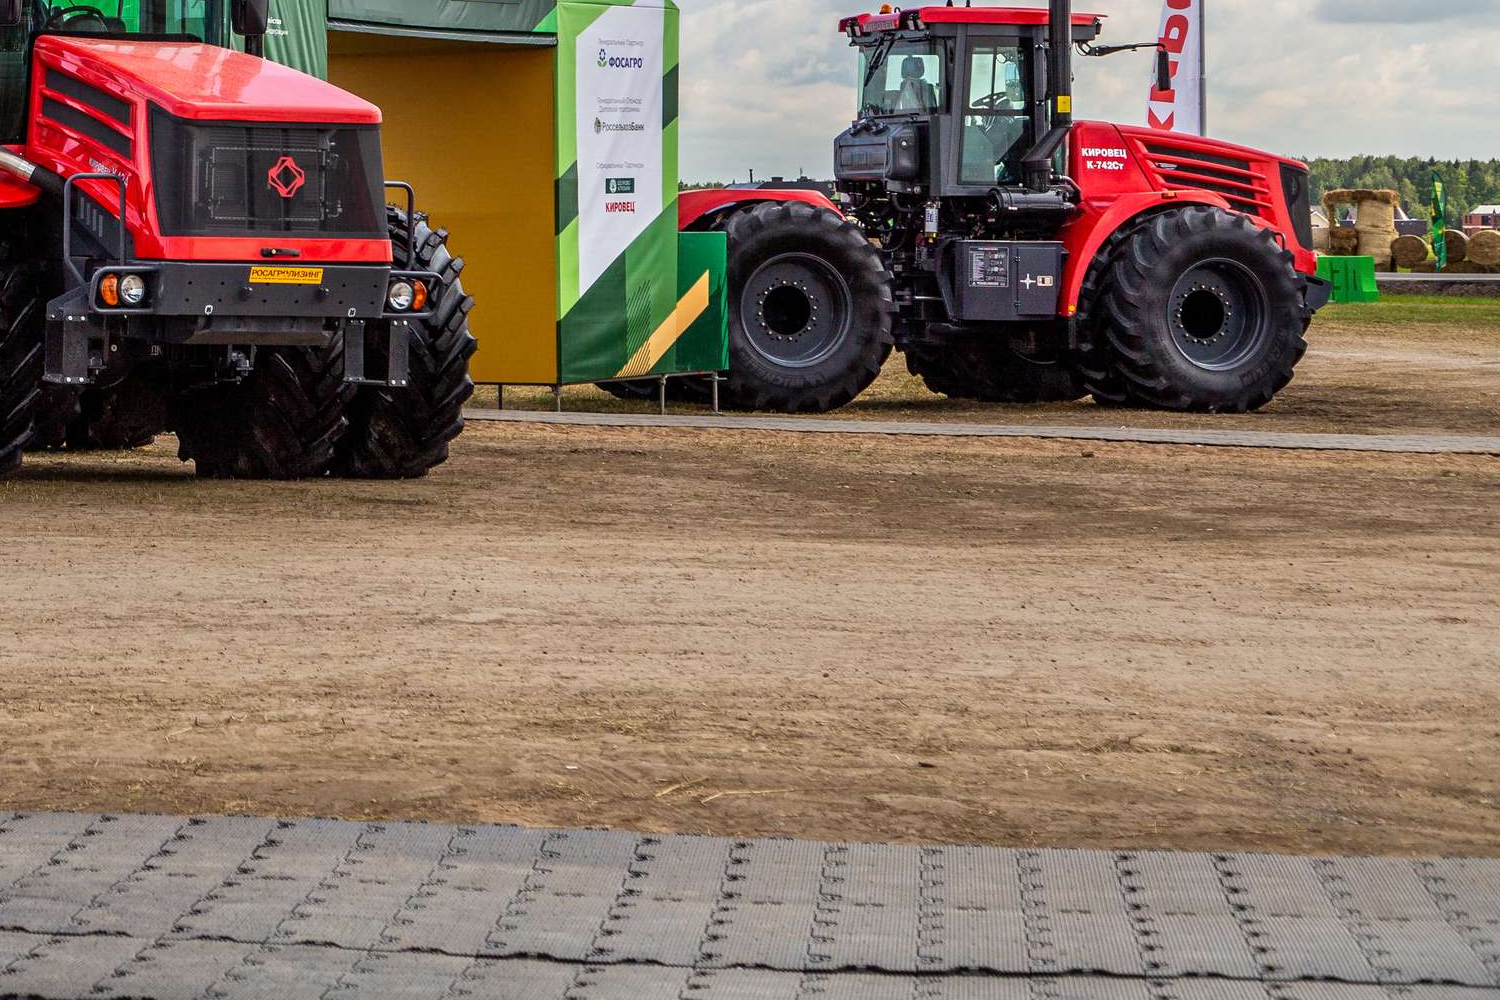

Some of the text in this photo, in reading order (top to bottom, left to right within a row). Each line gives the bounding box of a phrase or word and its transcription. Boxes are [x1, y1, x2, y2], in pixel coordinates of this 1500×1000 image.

[608, 57, 643, 68] ФОСАГРО
[1081, 147, 1128, 160] КИРОВЕЦ
[605, 201, 636, 214] КИРОВЕЦ
